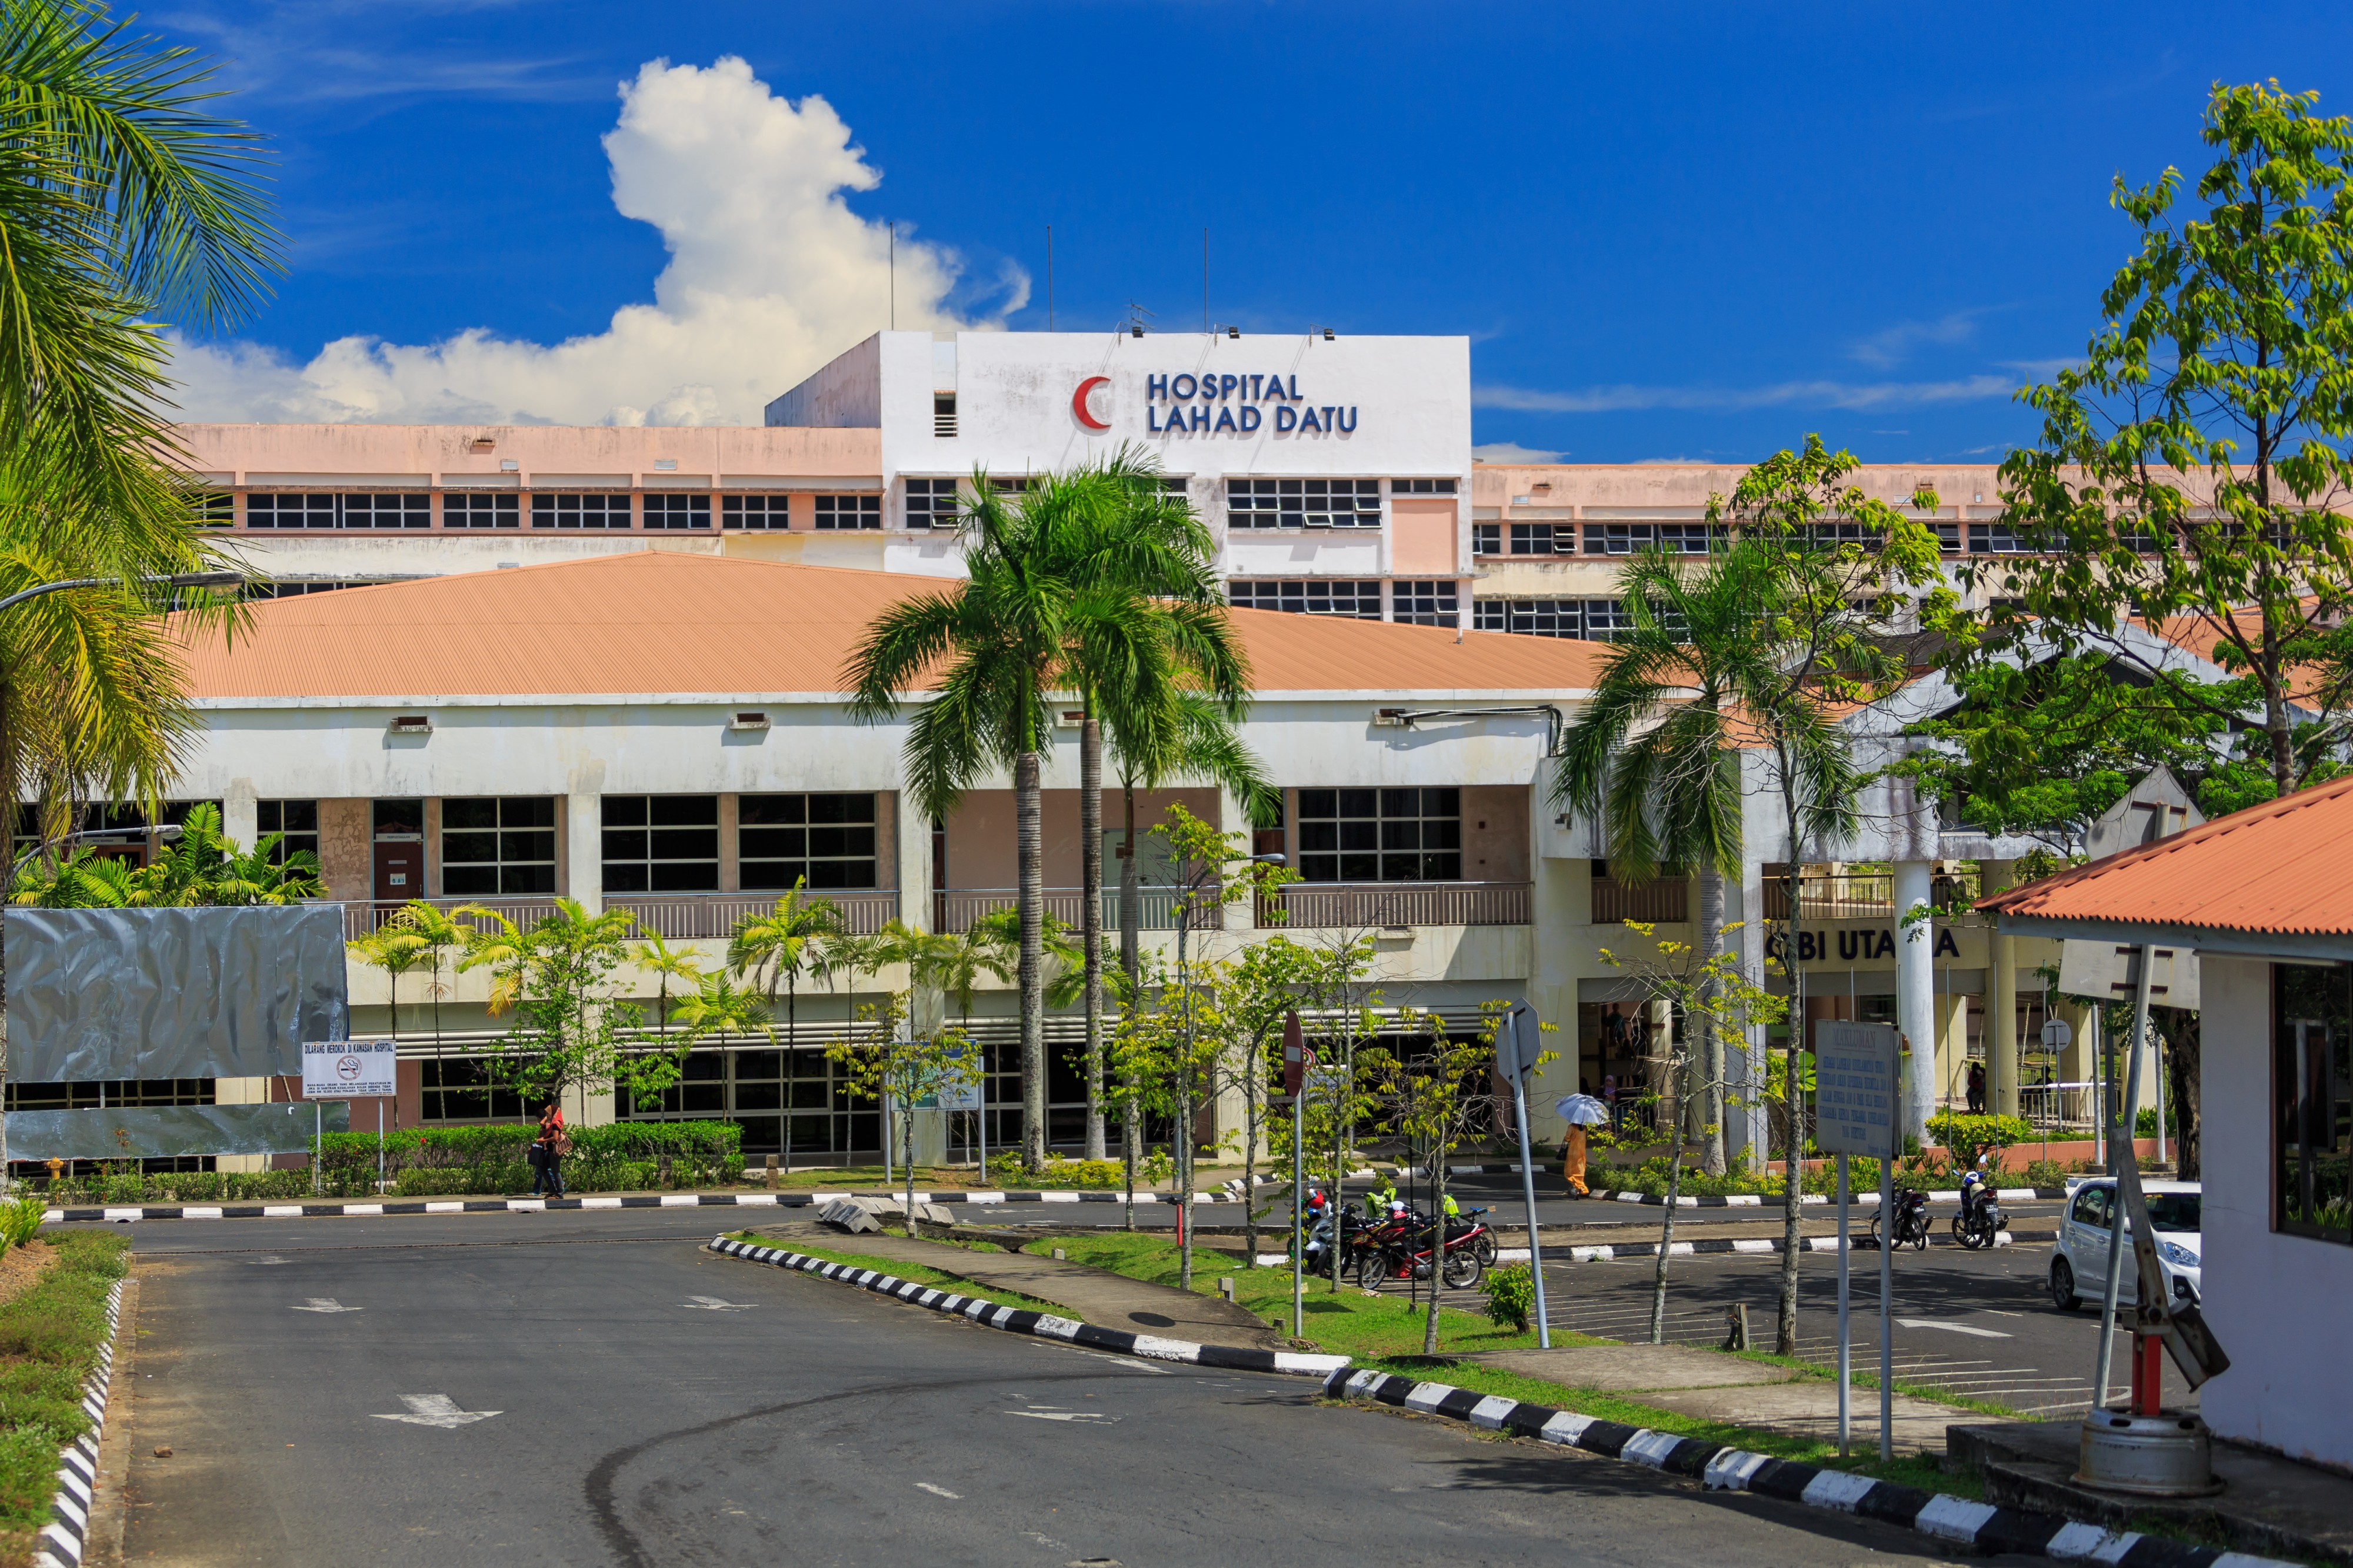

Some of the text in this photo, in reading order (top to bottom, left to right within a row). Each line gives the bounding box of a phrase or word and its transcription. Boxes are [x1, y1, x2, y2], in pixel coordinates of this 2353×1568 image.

[1148, 373, 1304, 401] HOSPITAL
[1149, 405, 1357, 432] LAHAD DATU
[1765, 929, 1960, 961] OBI UTAA
[305, 1043, 393, 1054] DILARANG MEROKOK DI KAWASAN HOSPITAL
[1832, 1028, 1876, 1048] MAKLUMAN
